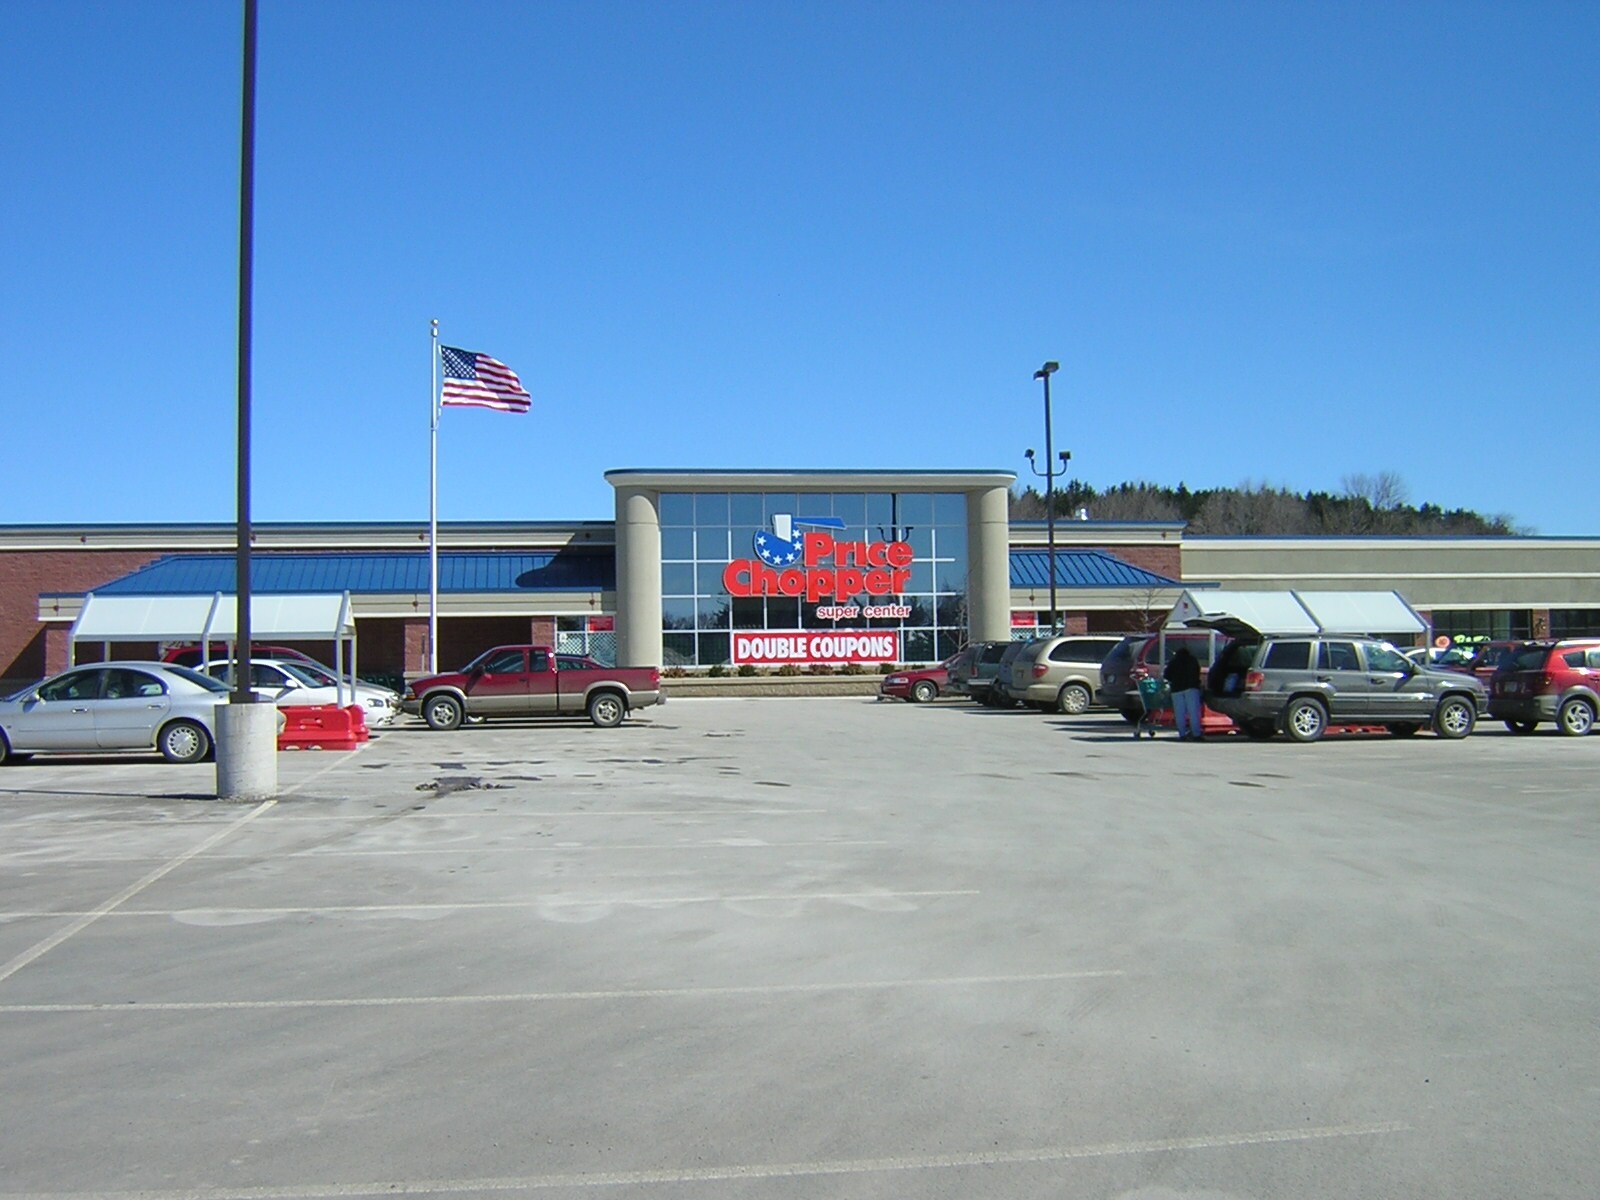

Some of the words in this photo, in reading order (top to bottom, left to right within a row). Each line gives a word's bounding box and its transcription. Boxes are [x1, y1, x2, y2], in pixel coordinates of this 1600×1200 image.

[804, 532, 913, 567] Price
[723, 559, 911, 602] Chopper
[816, 605, 859, 621] super
[863, 603, 912, 618] center
[738, 637, 807, 659] DOUBLE
[810, 636, 893, 658] COUPONS
